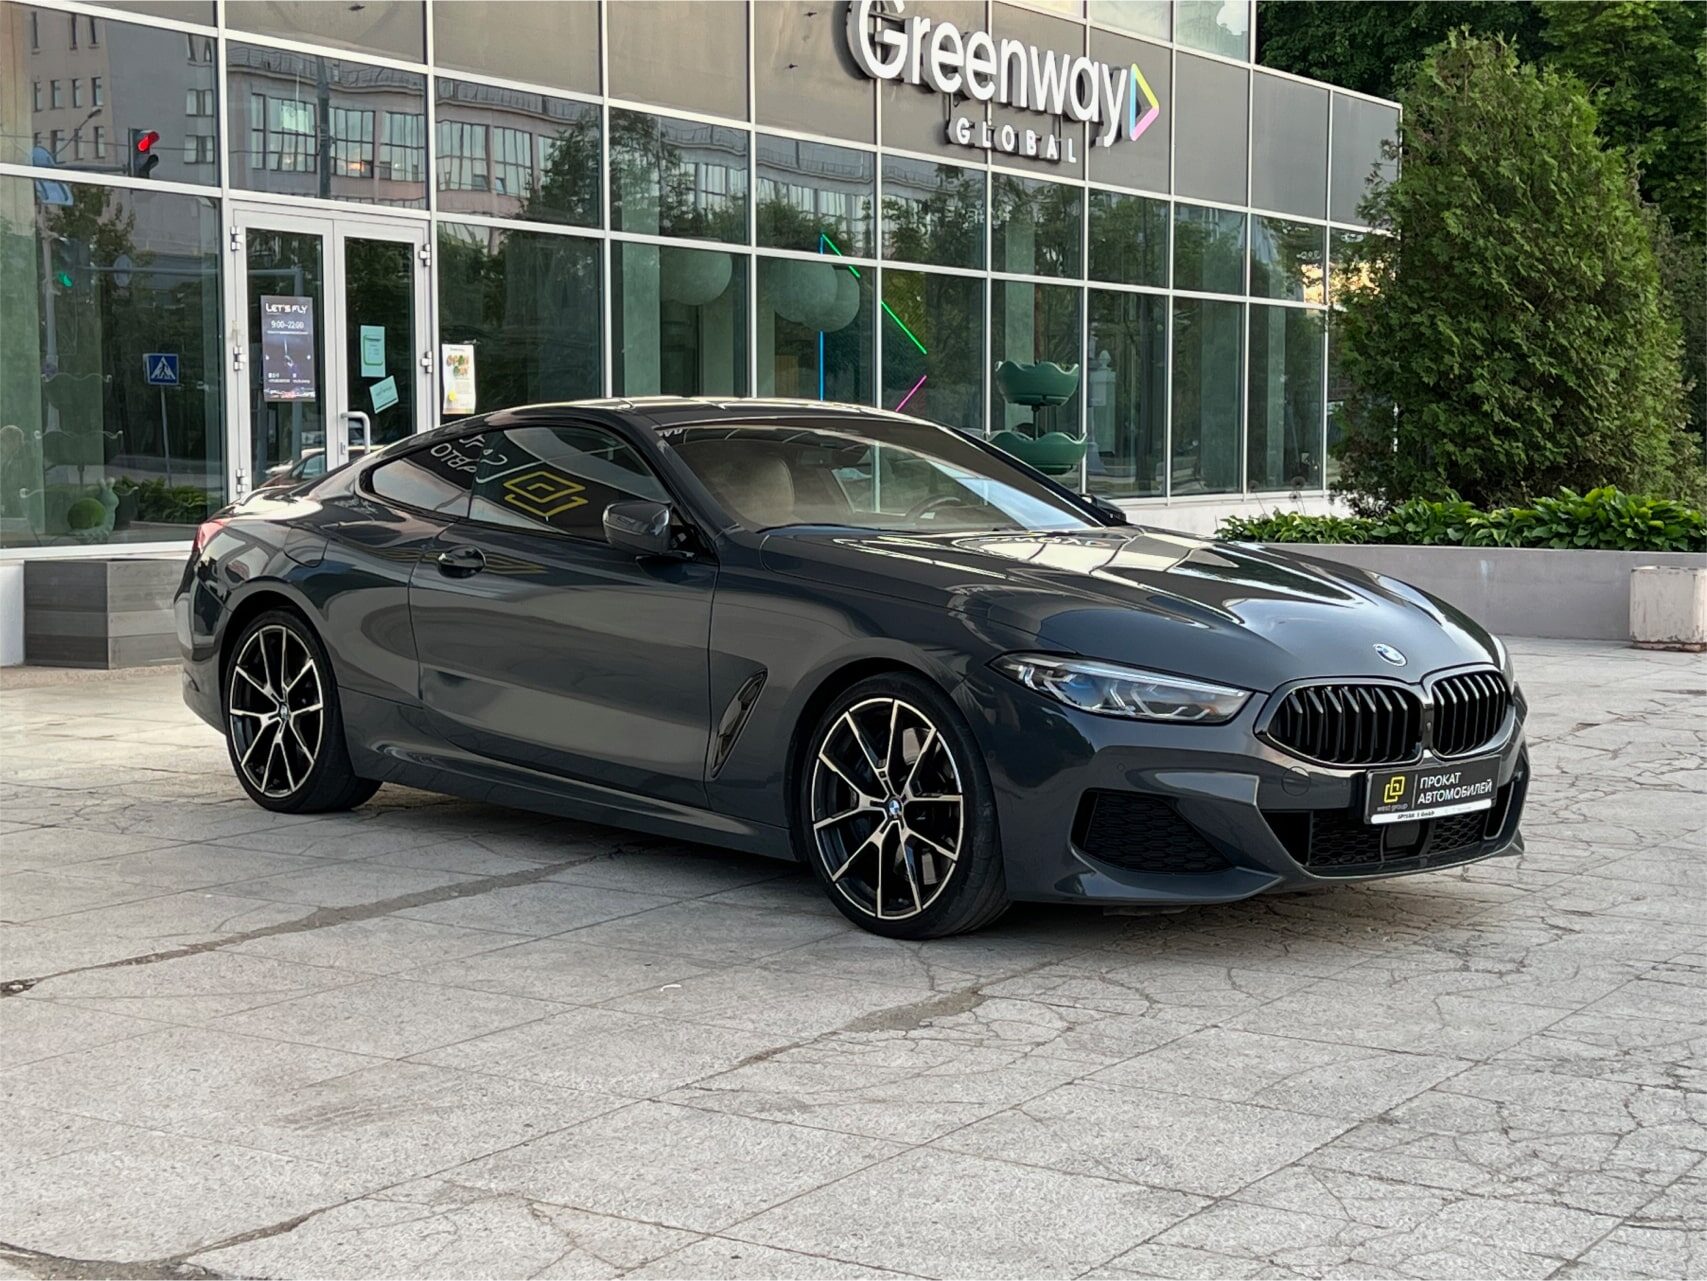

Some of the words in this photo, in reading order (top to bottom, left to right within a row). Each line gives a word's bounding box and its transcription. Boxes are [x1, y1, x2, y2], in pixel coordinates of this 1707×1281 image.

[854, 0, 1128, 148] Greenway
[955, 116, 1078, 164] GLOBAL
[1417, 778, 1493, 805] АВТОМОБИЛЕЙ
[1420, 771, 1461, 790] ПРОКАТ
